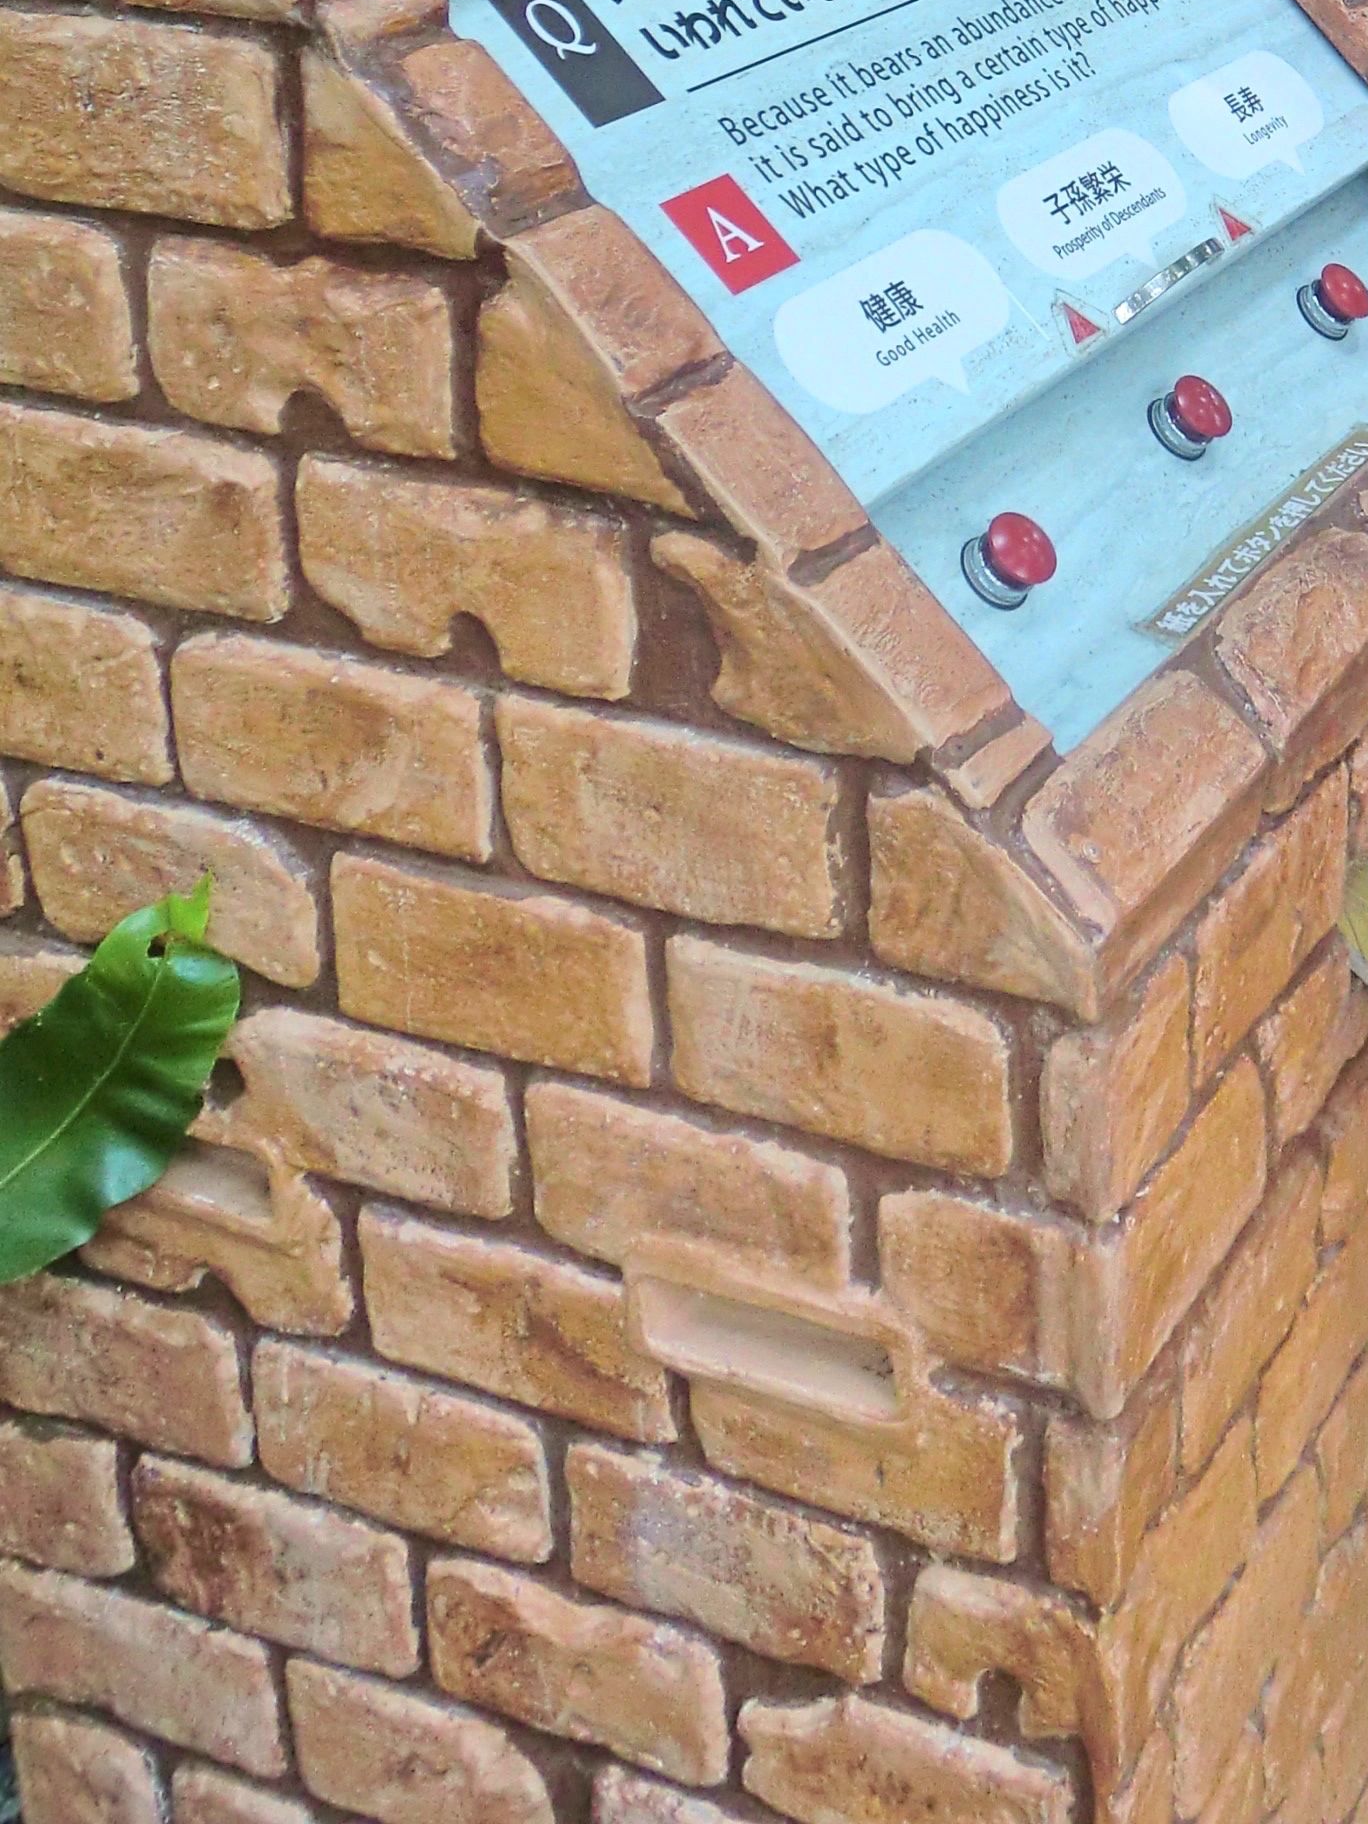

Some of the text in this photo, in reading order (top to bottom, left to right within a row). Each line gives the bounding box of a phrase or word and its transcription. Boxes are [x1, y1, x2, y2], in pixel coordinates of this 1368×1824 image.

[718, 86, 833, 146] Because
[826, 73, 858, 98] it
[848, 47, 922, 88] bears
[921, 34, 954, 60] an
[749, 156, 783, 183] it
[775, 145, 808, 171] is
[808, 113, 864, 159] said
[860, 108, 893, 132] to
[886, 76, 962, 118] bring
[956, 70, 976, 89] a
[975, 35, 1049, 80] certain
[1043, 17, 1093, 52] type
[1090, 0, 1112, 27] of
[1223, 86, 1264, 123] 長寿
[778, 51, 1097, 219] What type of happiness is it?
[1243, 114, 1288, 145] Longevity
[1042, 160, 1132, 225] 子孫繁栄
[1052, 186, 1167, 260] Prosperity of Descendants
[707, 206, 765, 264] A
[859, 280, 924, 333] 健康
[876, 310, 961, 366] Good Health
